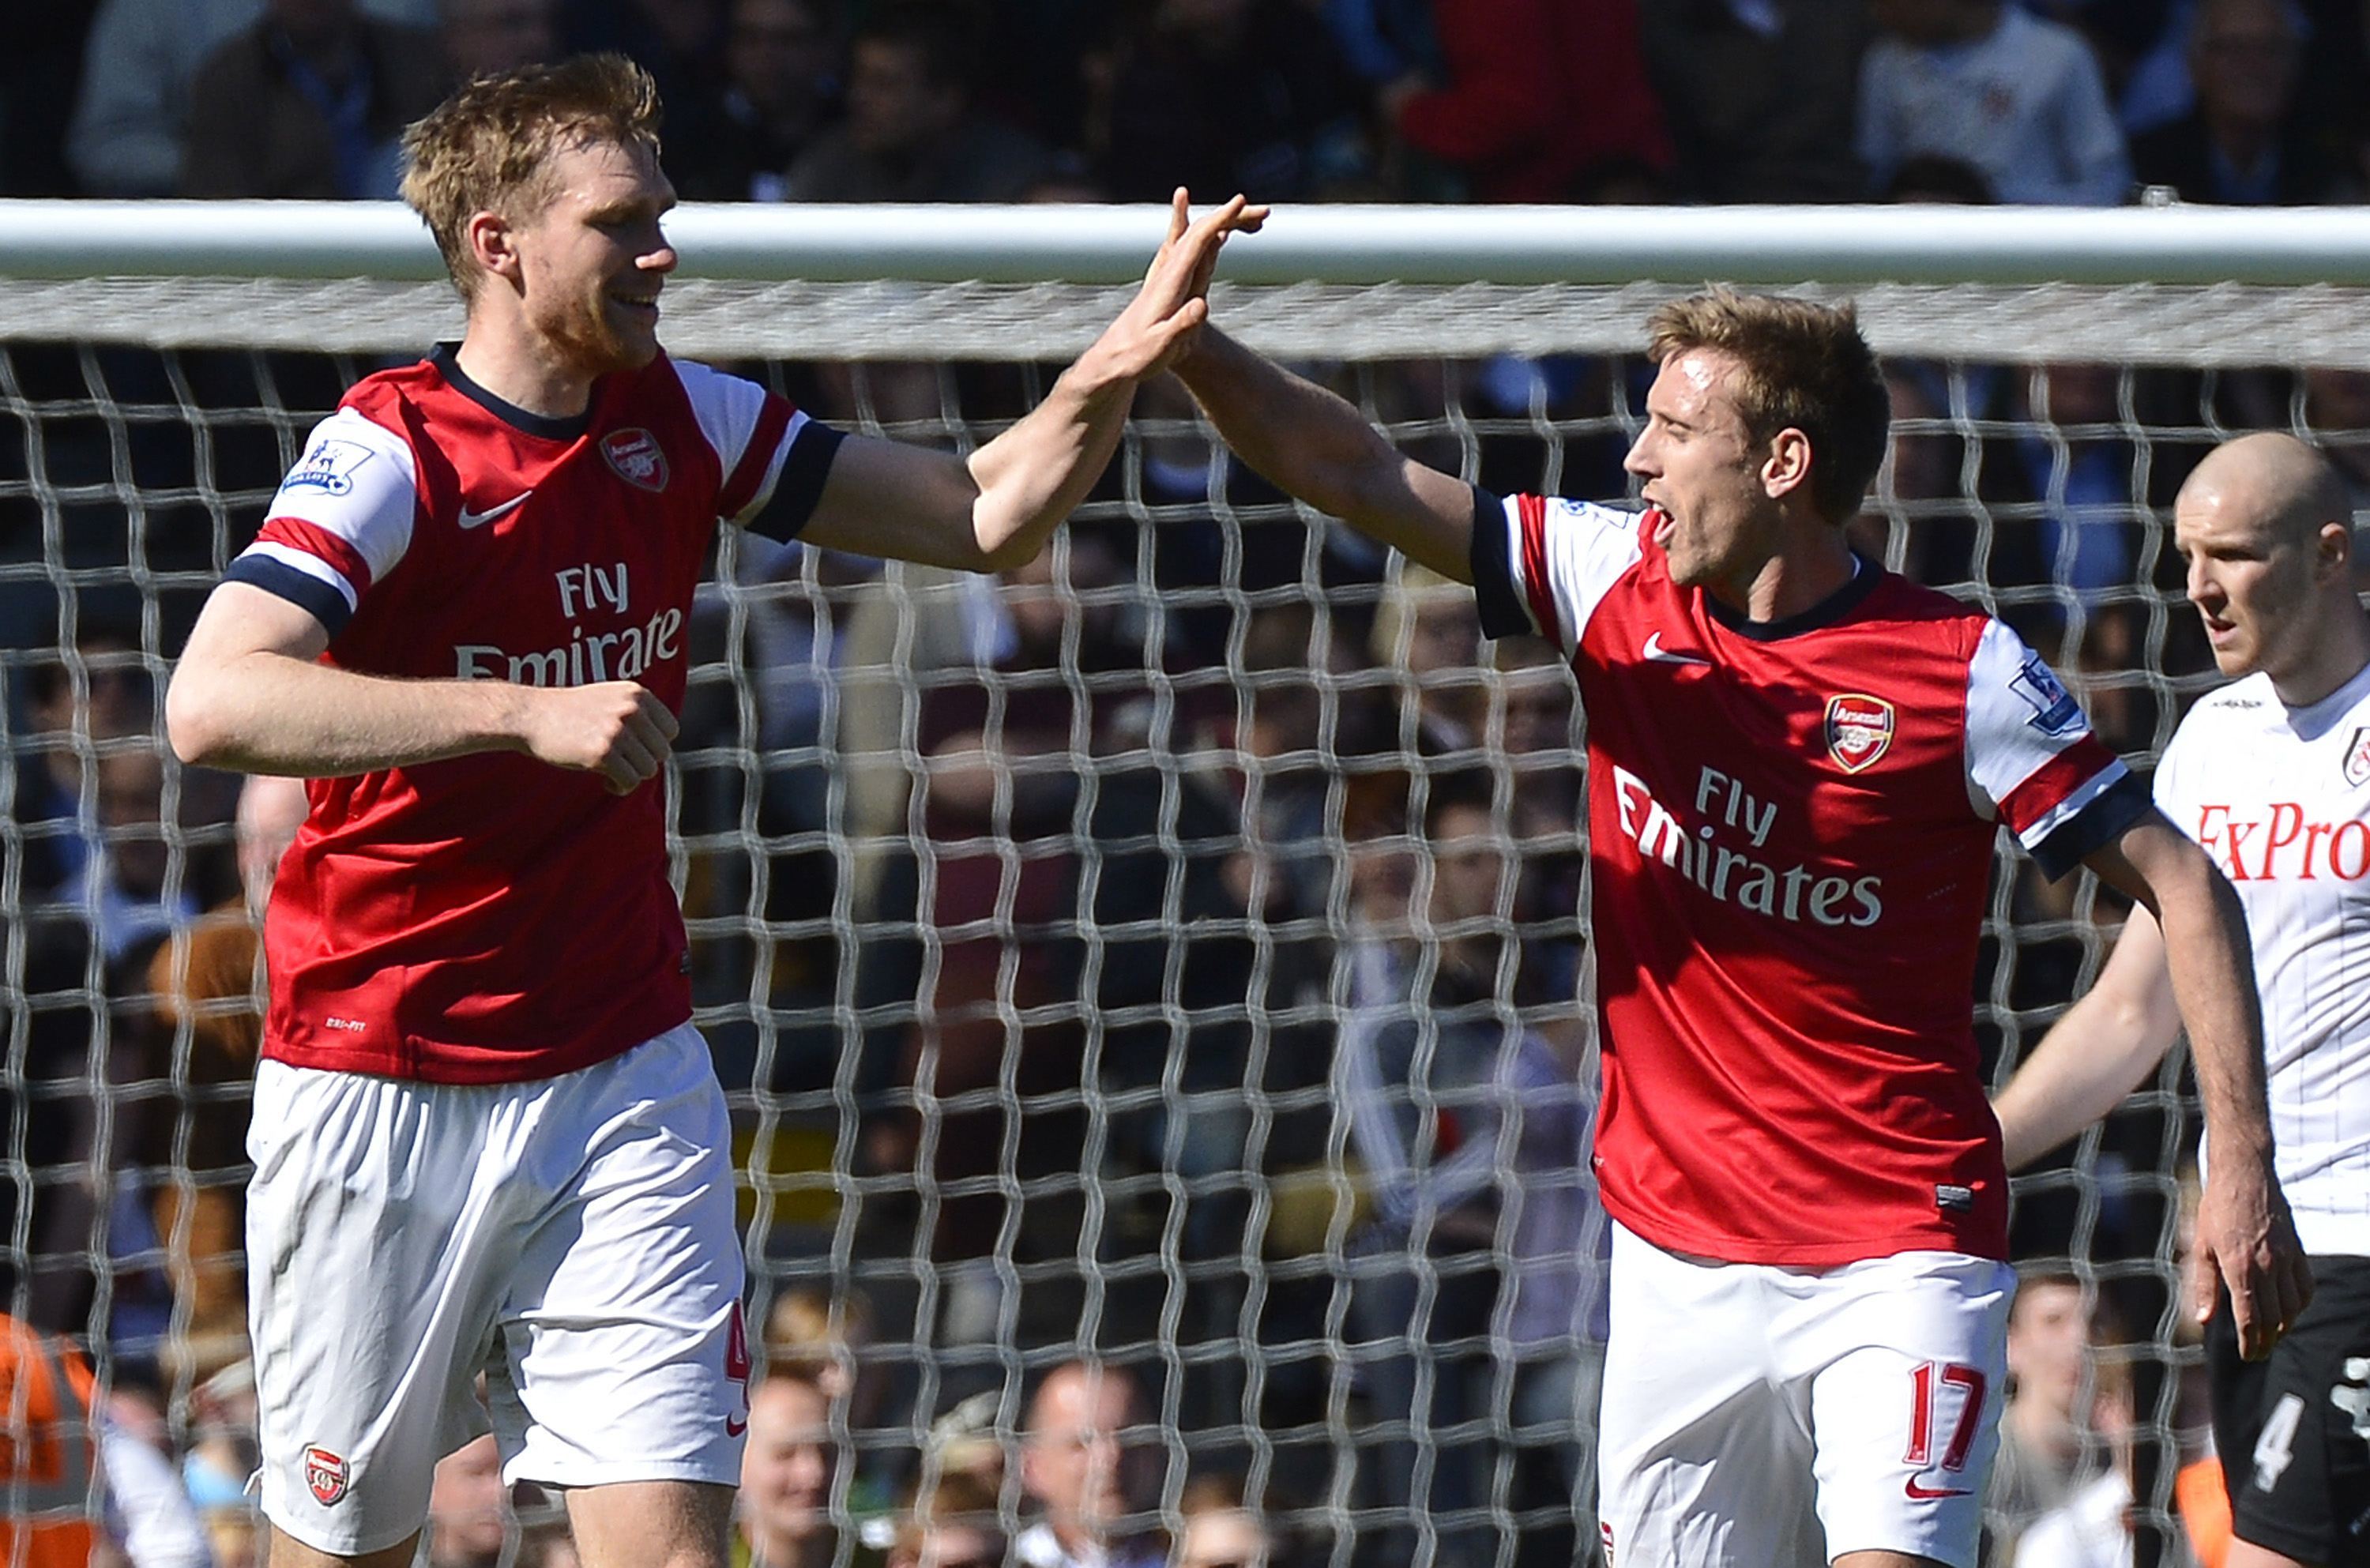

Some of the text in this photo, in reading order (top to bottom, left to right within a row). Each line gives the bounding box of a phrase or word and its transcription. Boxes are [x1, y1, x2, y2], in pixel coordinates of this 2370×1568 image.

[555, 562, 630, 619] Fly
[1833, 706, 1885, 726] Arsenal
[1613, 765, 1883, 927] Emirates
[1695, 765, 1778, 848] Fly
[1902, 1360, 1988, 1473] 17
[2252, 1391, 2306, 1494] 4
